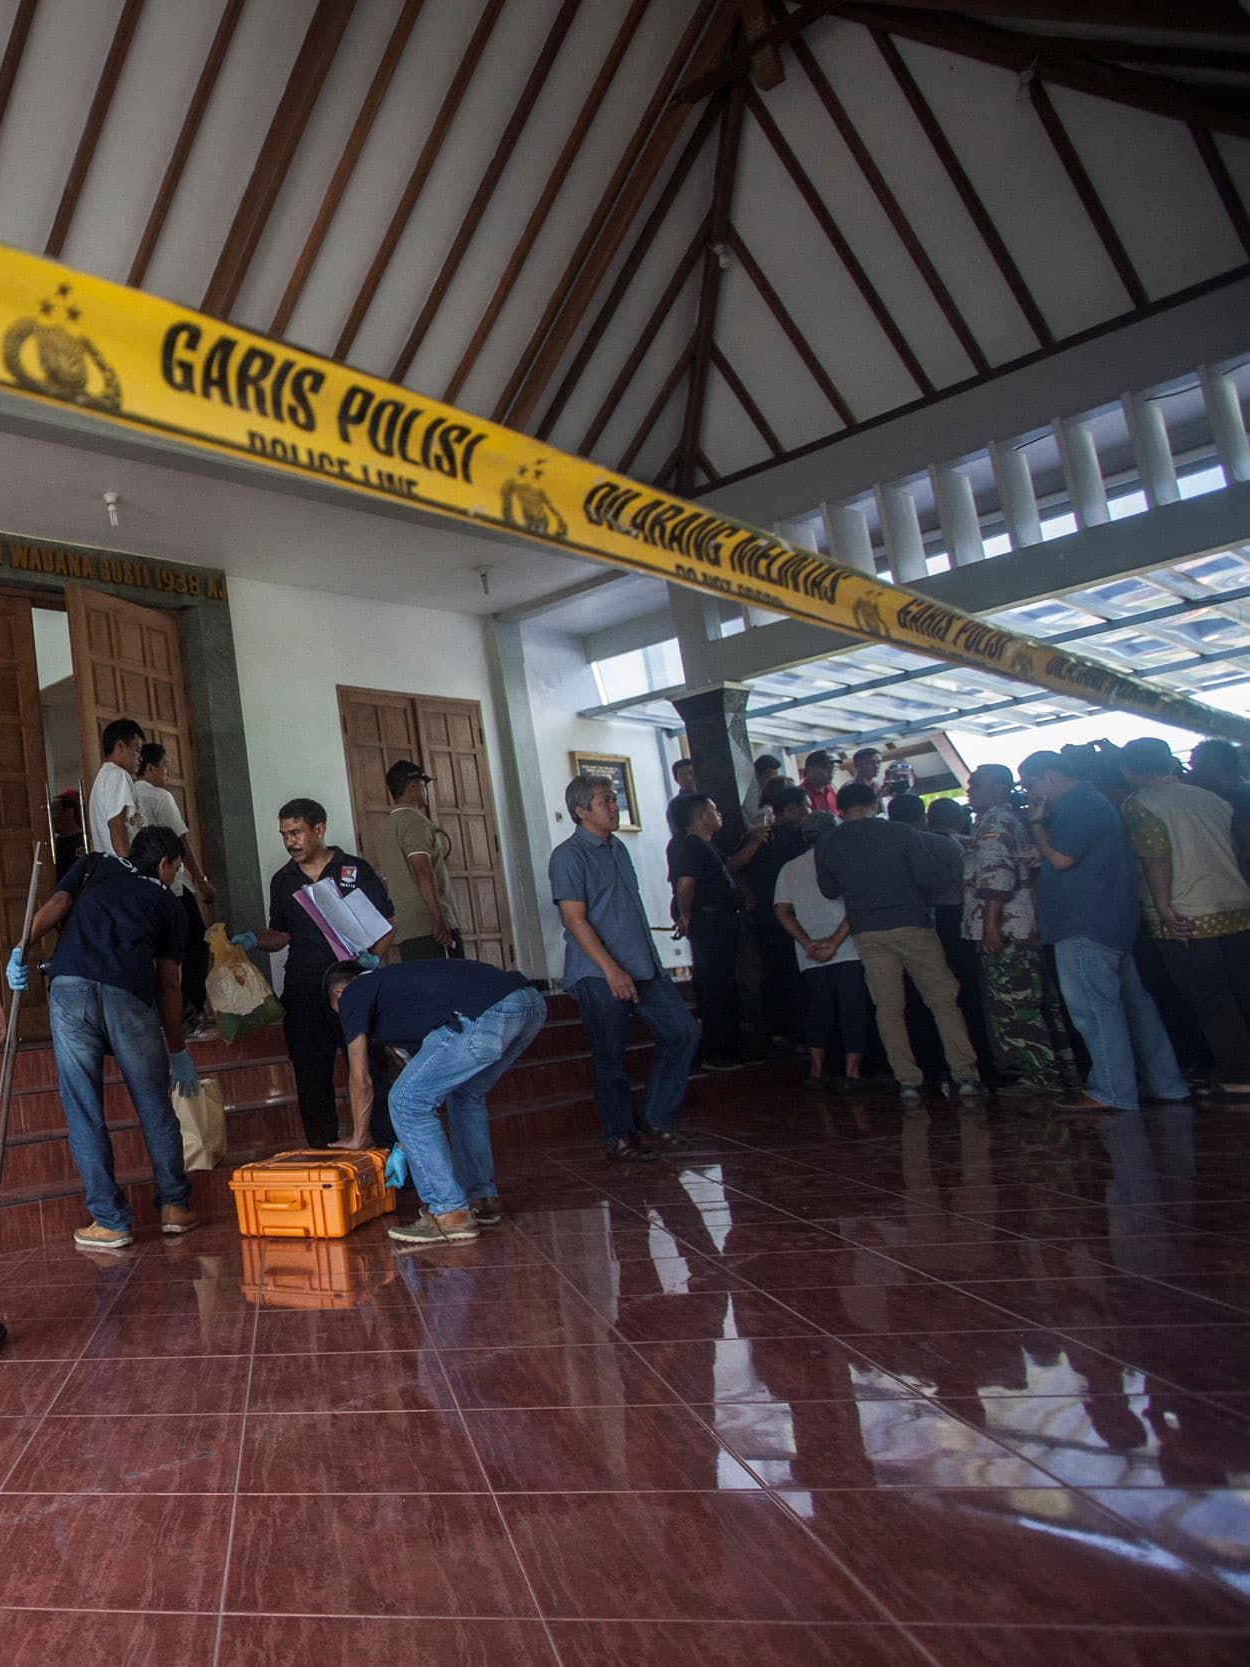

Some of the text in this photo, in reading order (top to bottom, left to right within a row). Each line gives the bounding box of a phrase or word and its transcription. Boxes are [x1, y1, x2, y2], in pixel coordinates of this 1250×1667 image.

[160, 320, 488, 484] GARIS POLISI
[583, 481, 740, 568] DILARANG
[99, 559, 149, 588] GUSTI
[155, 567, 200, 598] 1938
